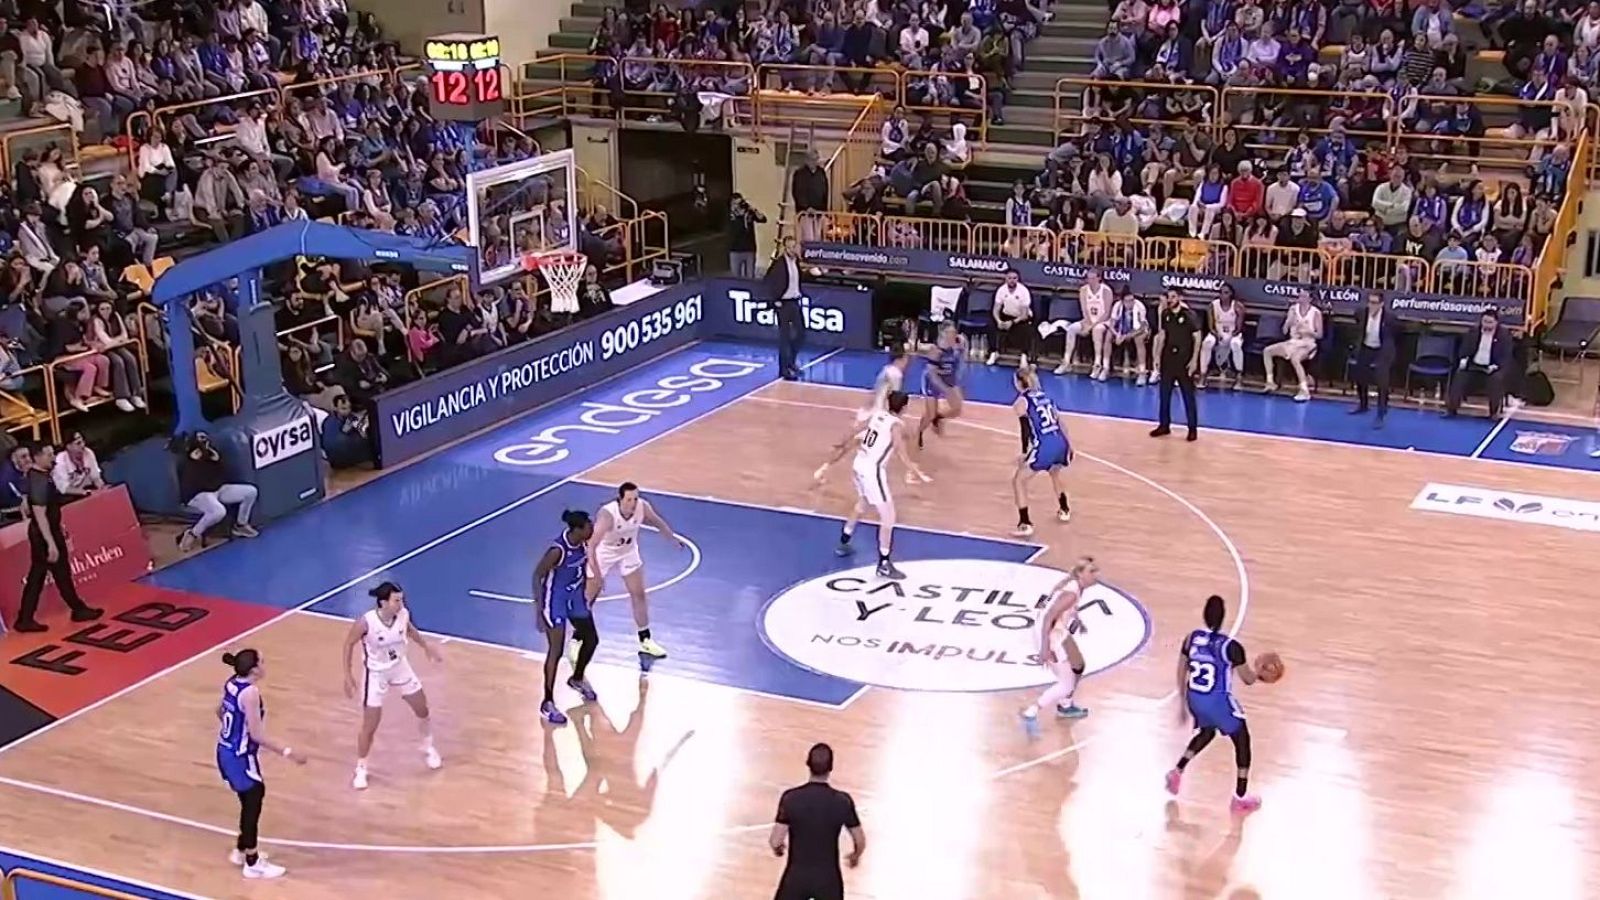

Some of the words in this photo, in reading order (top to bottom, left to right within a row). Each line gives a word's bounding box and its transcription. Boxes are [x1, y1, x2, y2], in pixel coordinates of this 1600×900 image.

[432, 71, 468, 104] 12
[475, 68, 499, 101] 12
[949, 256, 1009, 271] SALAMANCA
[1103, 269, 1131, 281] LEÓN
[729, 290, 844, 332] Traisa
[1319, 289, 1327, 300] Y
[1330, 289, 1360, 301] LEÓN
[392, 383, 486, 436] VIGILANCIA
[488, 375, 500, 398] Y
[502, 341, 594, 394] PROTECCIÓN
[601, 321, 639, 360] 900
[642, 306, 672, 343] 535
[675, 296, 702, 329] 961
[493, 358, 764, 466] endesa
[863, 429, 878, 447] 10
[1426, 493, 1483, 504] LF
[855, 600, 893, 621] Y
[9, 602, 210, 676] FEB
[811, 634, 881, 648] NOS
[887, 640, 1058, 666] IMPULS
[1189, 660, 1216, 693] 23
